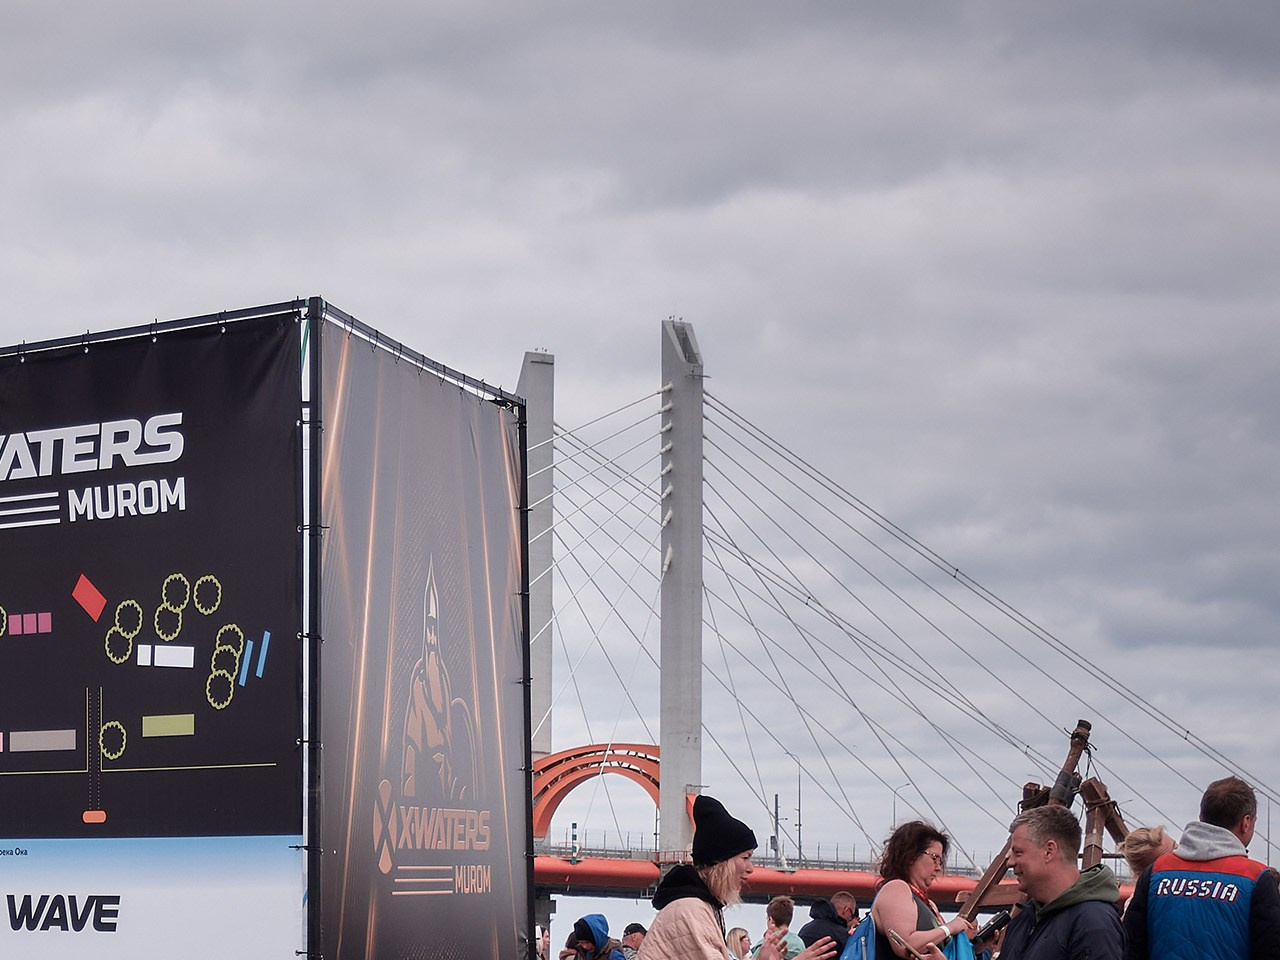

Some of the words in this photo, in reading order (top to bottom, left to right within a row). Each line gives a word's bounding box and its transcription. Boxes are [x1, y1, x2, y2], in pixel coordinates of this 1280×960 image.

[68, 477, 186, 522] MUROM
[14, 848, 28, 857] Ока
[455, 865, 491, 894] MUROM
[1157, 878, 1238, 903] RUSSIA
[7, 894, 121, 932] WAVE
